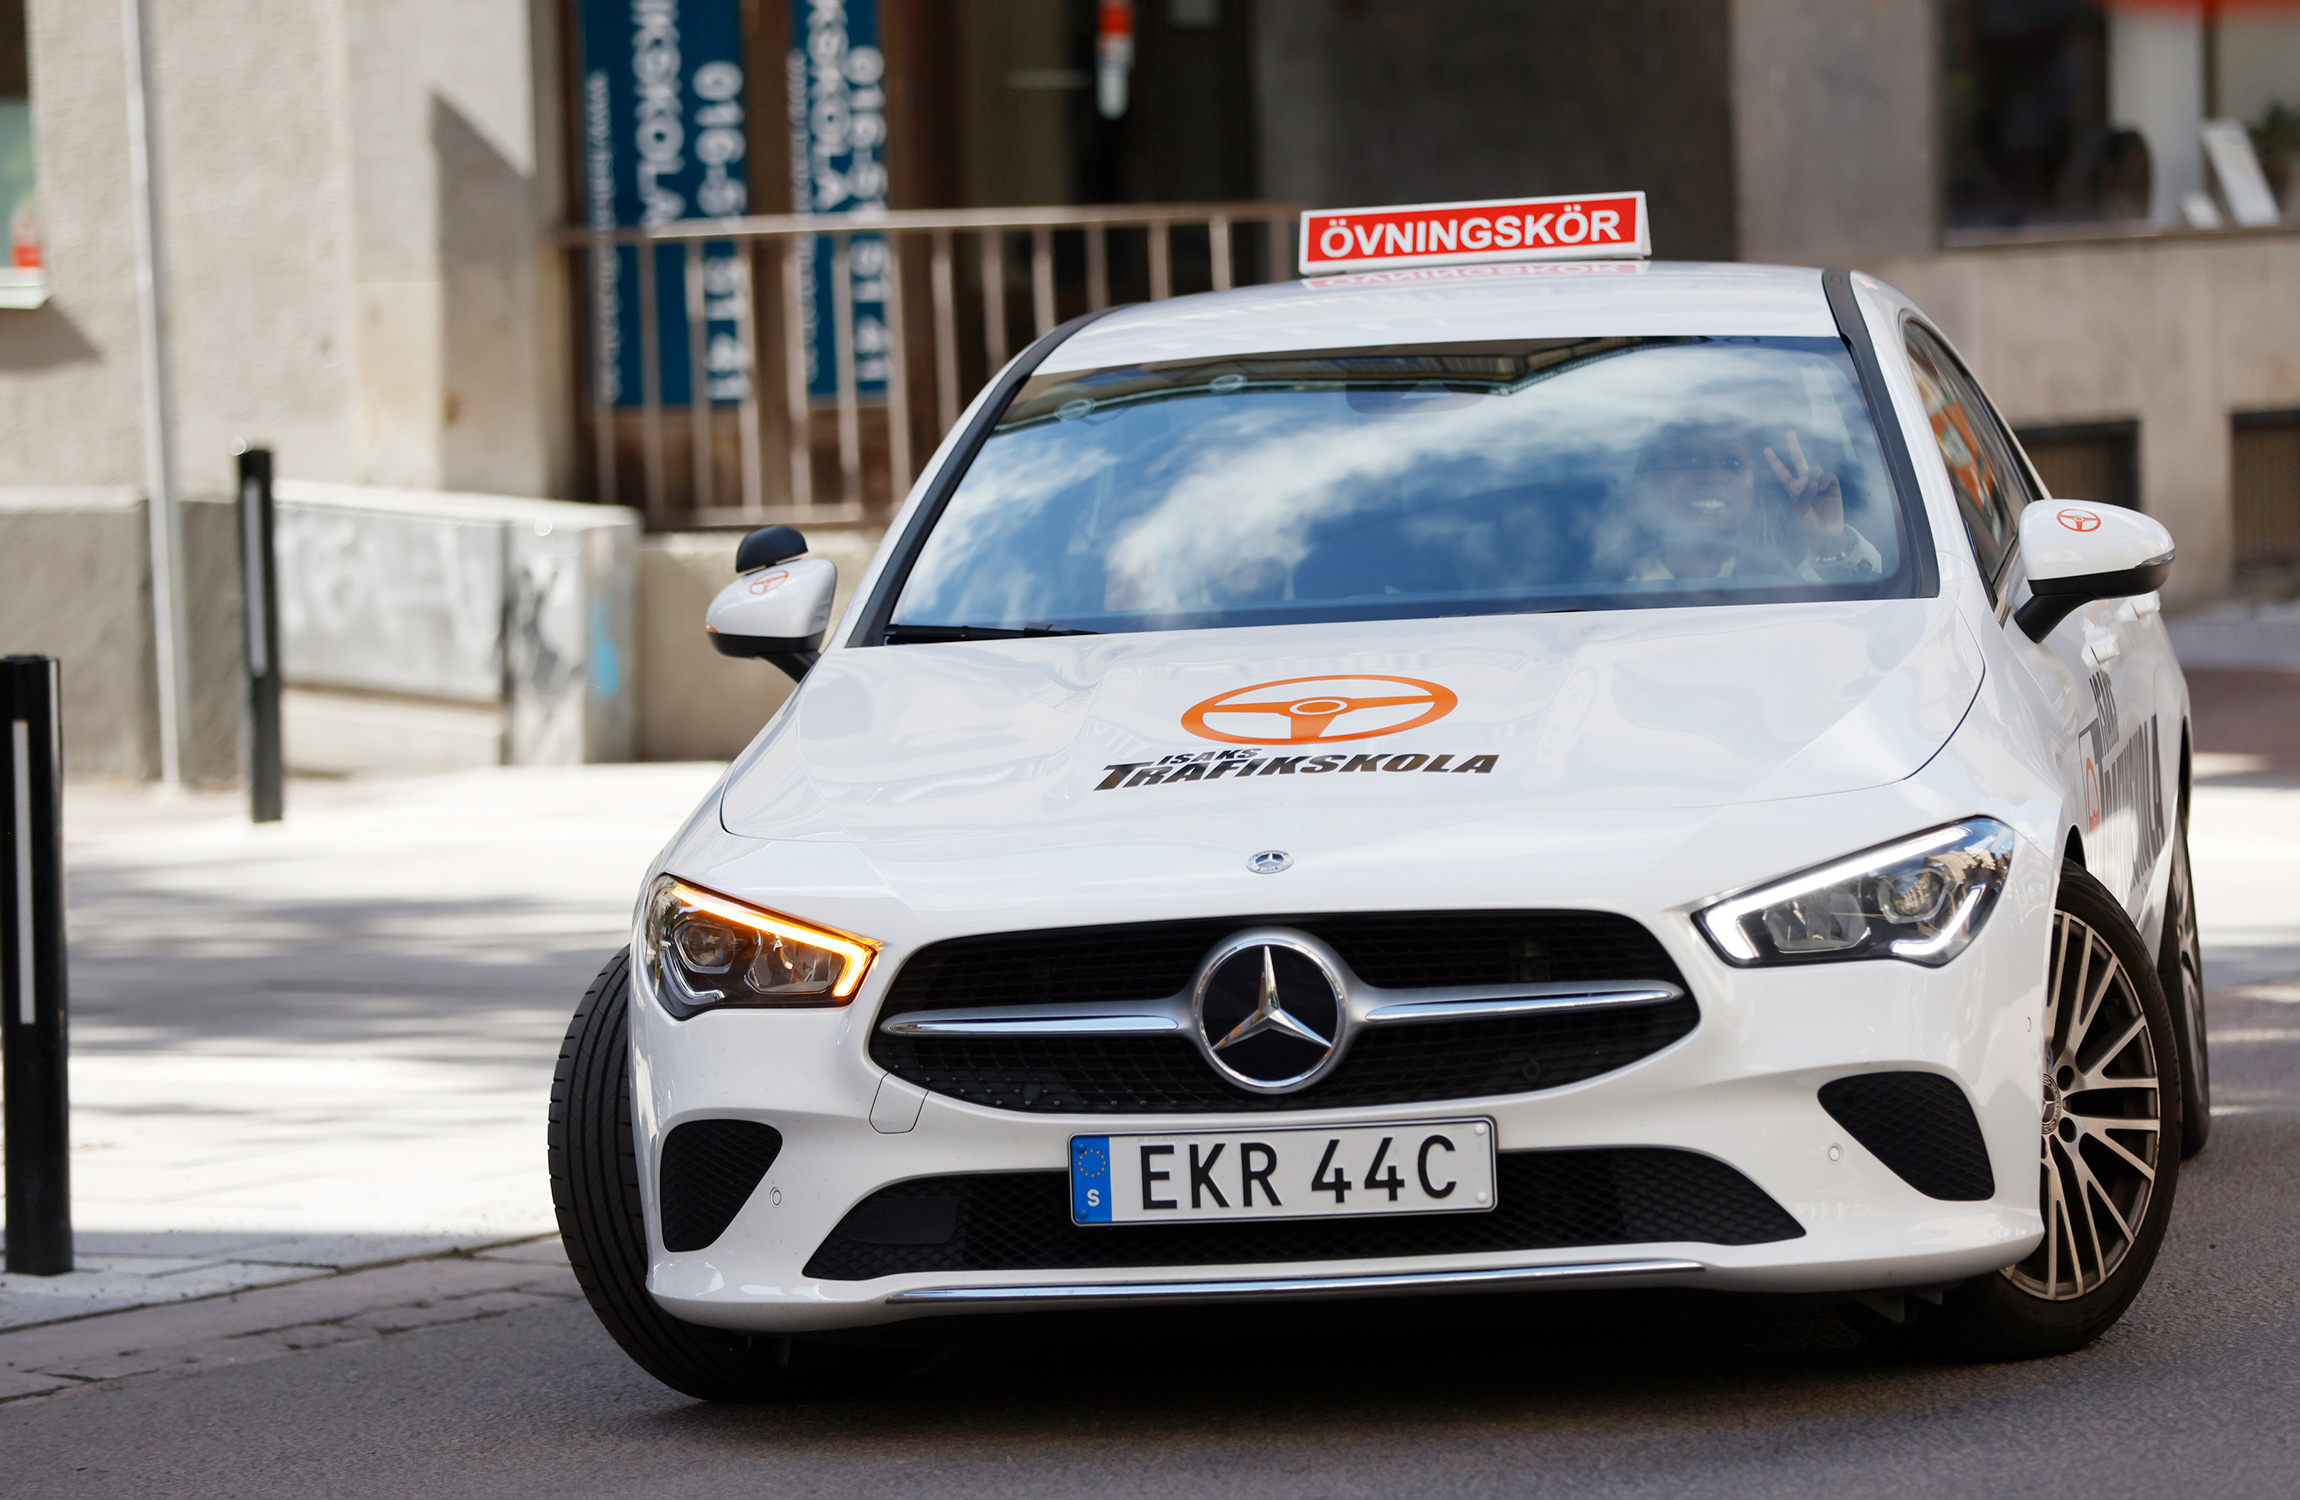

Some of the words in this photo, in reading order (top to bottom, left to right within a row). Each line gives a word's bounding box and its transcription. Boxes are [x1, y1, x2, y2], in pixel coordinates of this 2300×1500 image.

[692, 60, 748, 238] 016-5
[1320, 204, 1621, 258] ÖVNINGSKÖR
[1093, 754, 1500, 792] TRAFIKSKOLA
[1156, 748, 1262, 766] ISAKS
[1140, 1142, 1283, 1210] EKR
[1311, 1134, 1457, 1204] 44C
[1087, 1189, 1100, 1207] S
